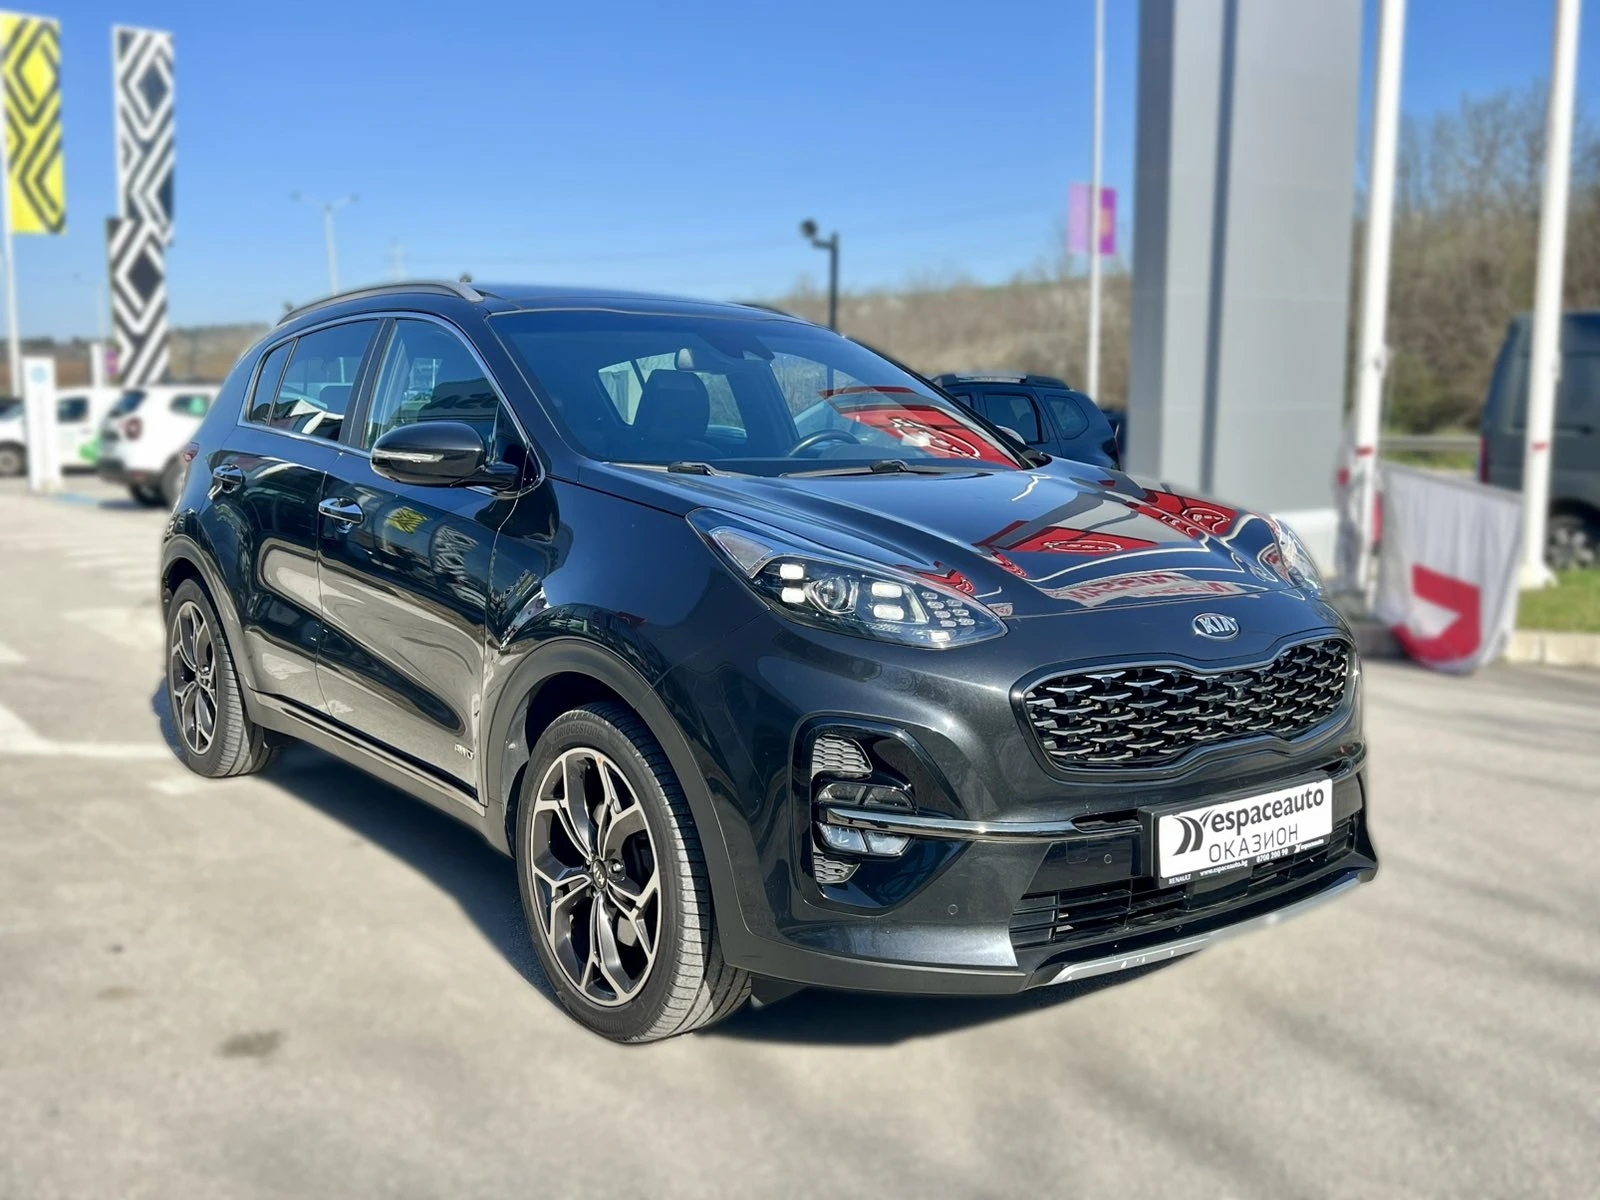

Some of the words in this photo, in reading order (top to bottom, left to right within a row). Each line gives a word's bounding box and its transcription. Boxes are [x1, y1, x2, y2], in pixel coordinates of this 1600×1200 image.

[1197, 616, 1236, 634] KIA
[1211, 787, 1325, 836] espaceauto
[1209, 824, 1298, 863] ОКАЗИОН
[1168, 873, 1192, 885] RENAULT
